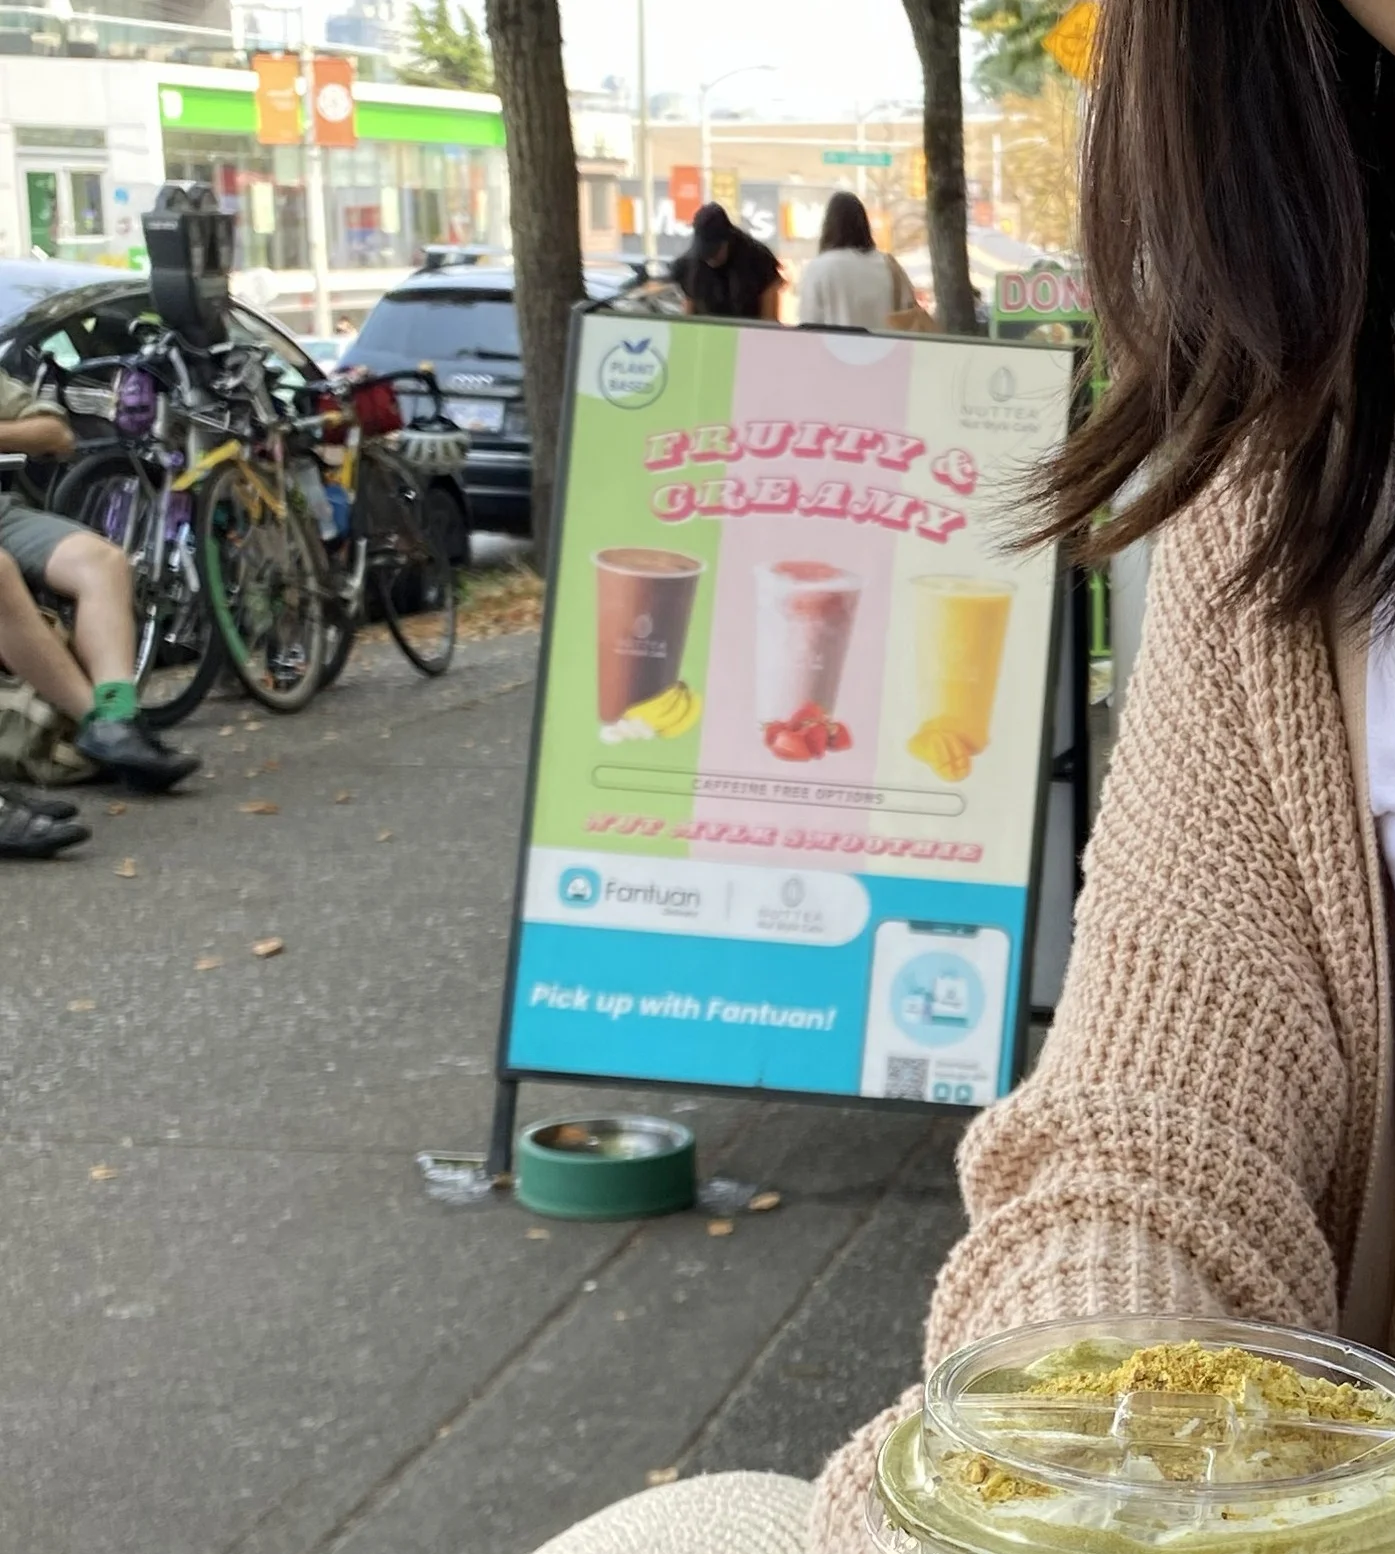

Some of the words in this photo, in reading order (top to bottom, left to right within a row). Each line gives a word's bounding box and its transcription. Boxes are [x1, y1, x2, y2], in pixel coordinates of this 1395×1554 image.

[610, 362, 655, 376] PLANT
[608, 379, 655, 395] BASED
[644, 421, 926, 471] FRUITY
[930, 448, 978, 495] &
[651, 477, 967, 544] CREAMY
[692, 778, 767, 796] CAFFEINE
[773, 785, 809, 800] FREE
[815, 788, 885, 805] OPTIONS
[783, 829, 985, 864] SMOOTHIE
[605, 881, 701, 908] Fantuan
[530, 983, 590, 1011] Pick
[595, 992, 633, 1020] up
[638, 991, 700, 1020] with
[705, 996, 838, 1031] Fantuan!
